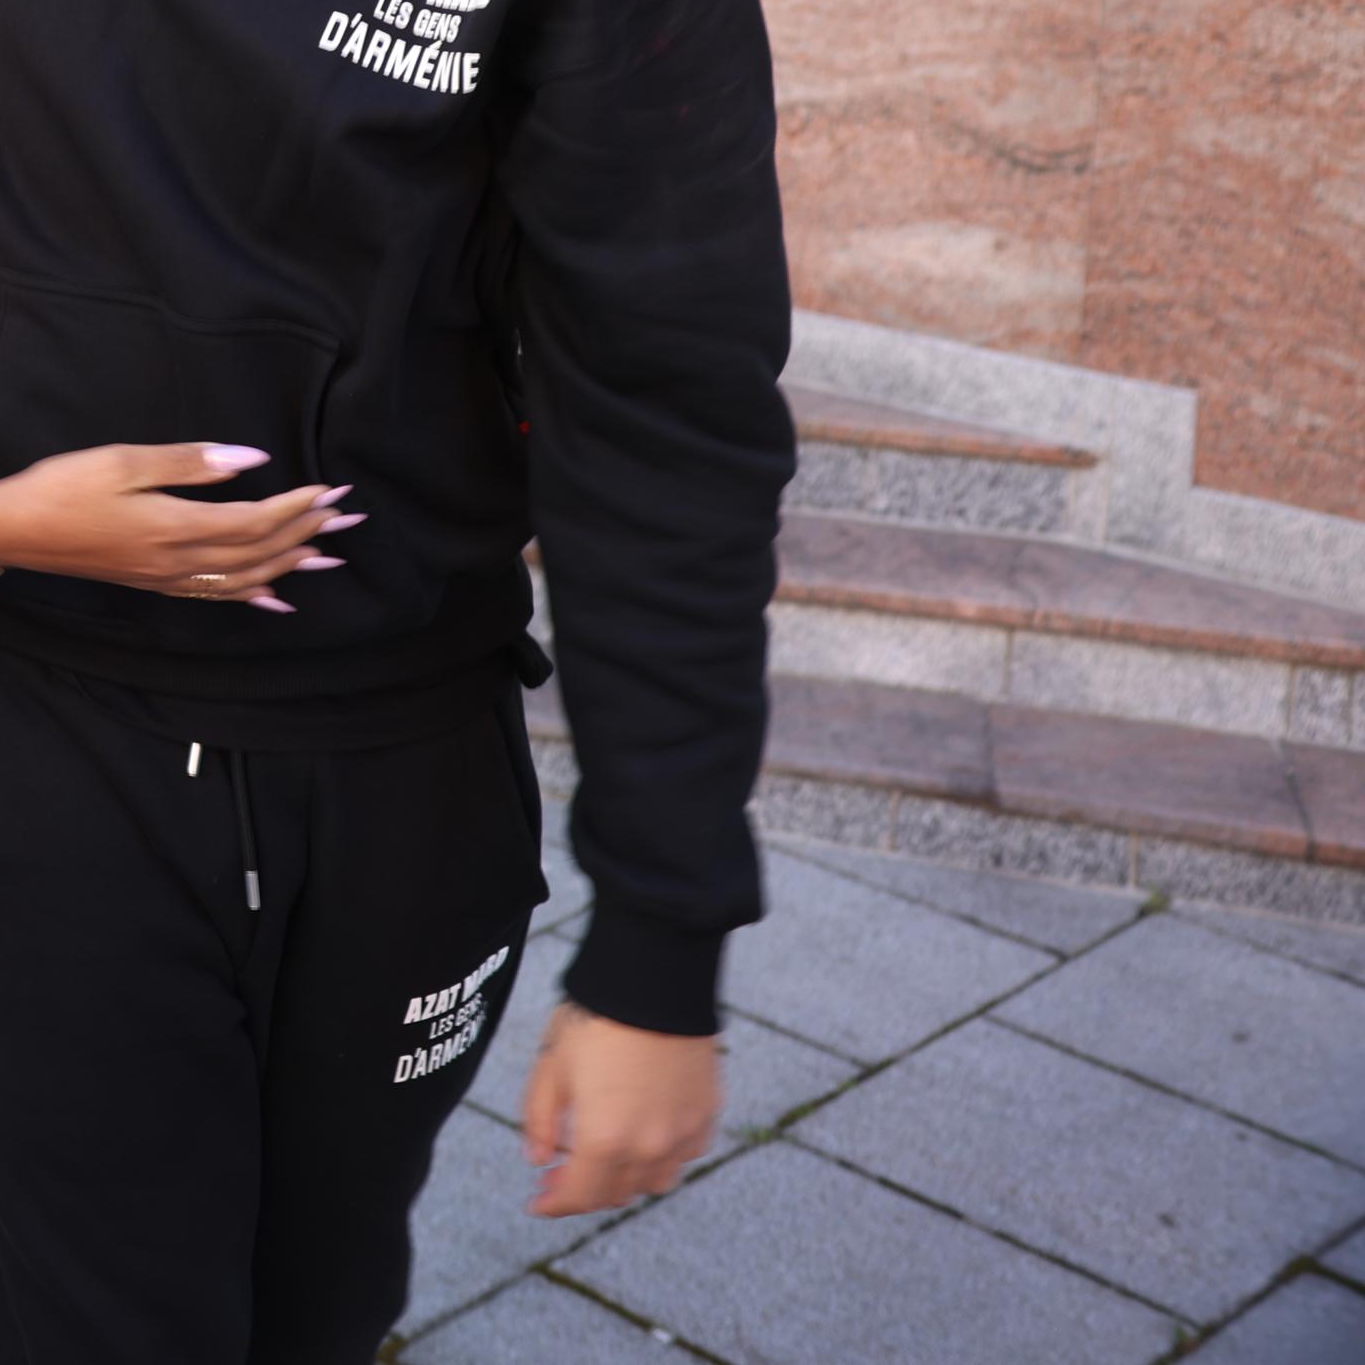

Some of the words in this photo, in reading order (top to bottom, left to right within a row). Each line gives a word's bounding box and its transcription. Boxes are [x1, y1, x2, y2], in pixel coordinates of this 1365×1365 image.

[413, 8, 462, 43] GENS
[319, 11, 480, 94] D'ARMÉNIE
[403, 983, 462, 1024] AZAT
[429, 1014, 454, 1039] LES
